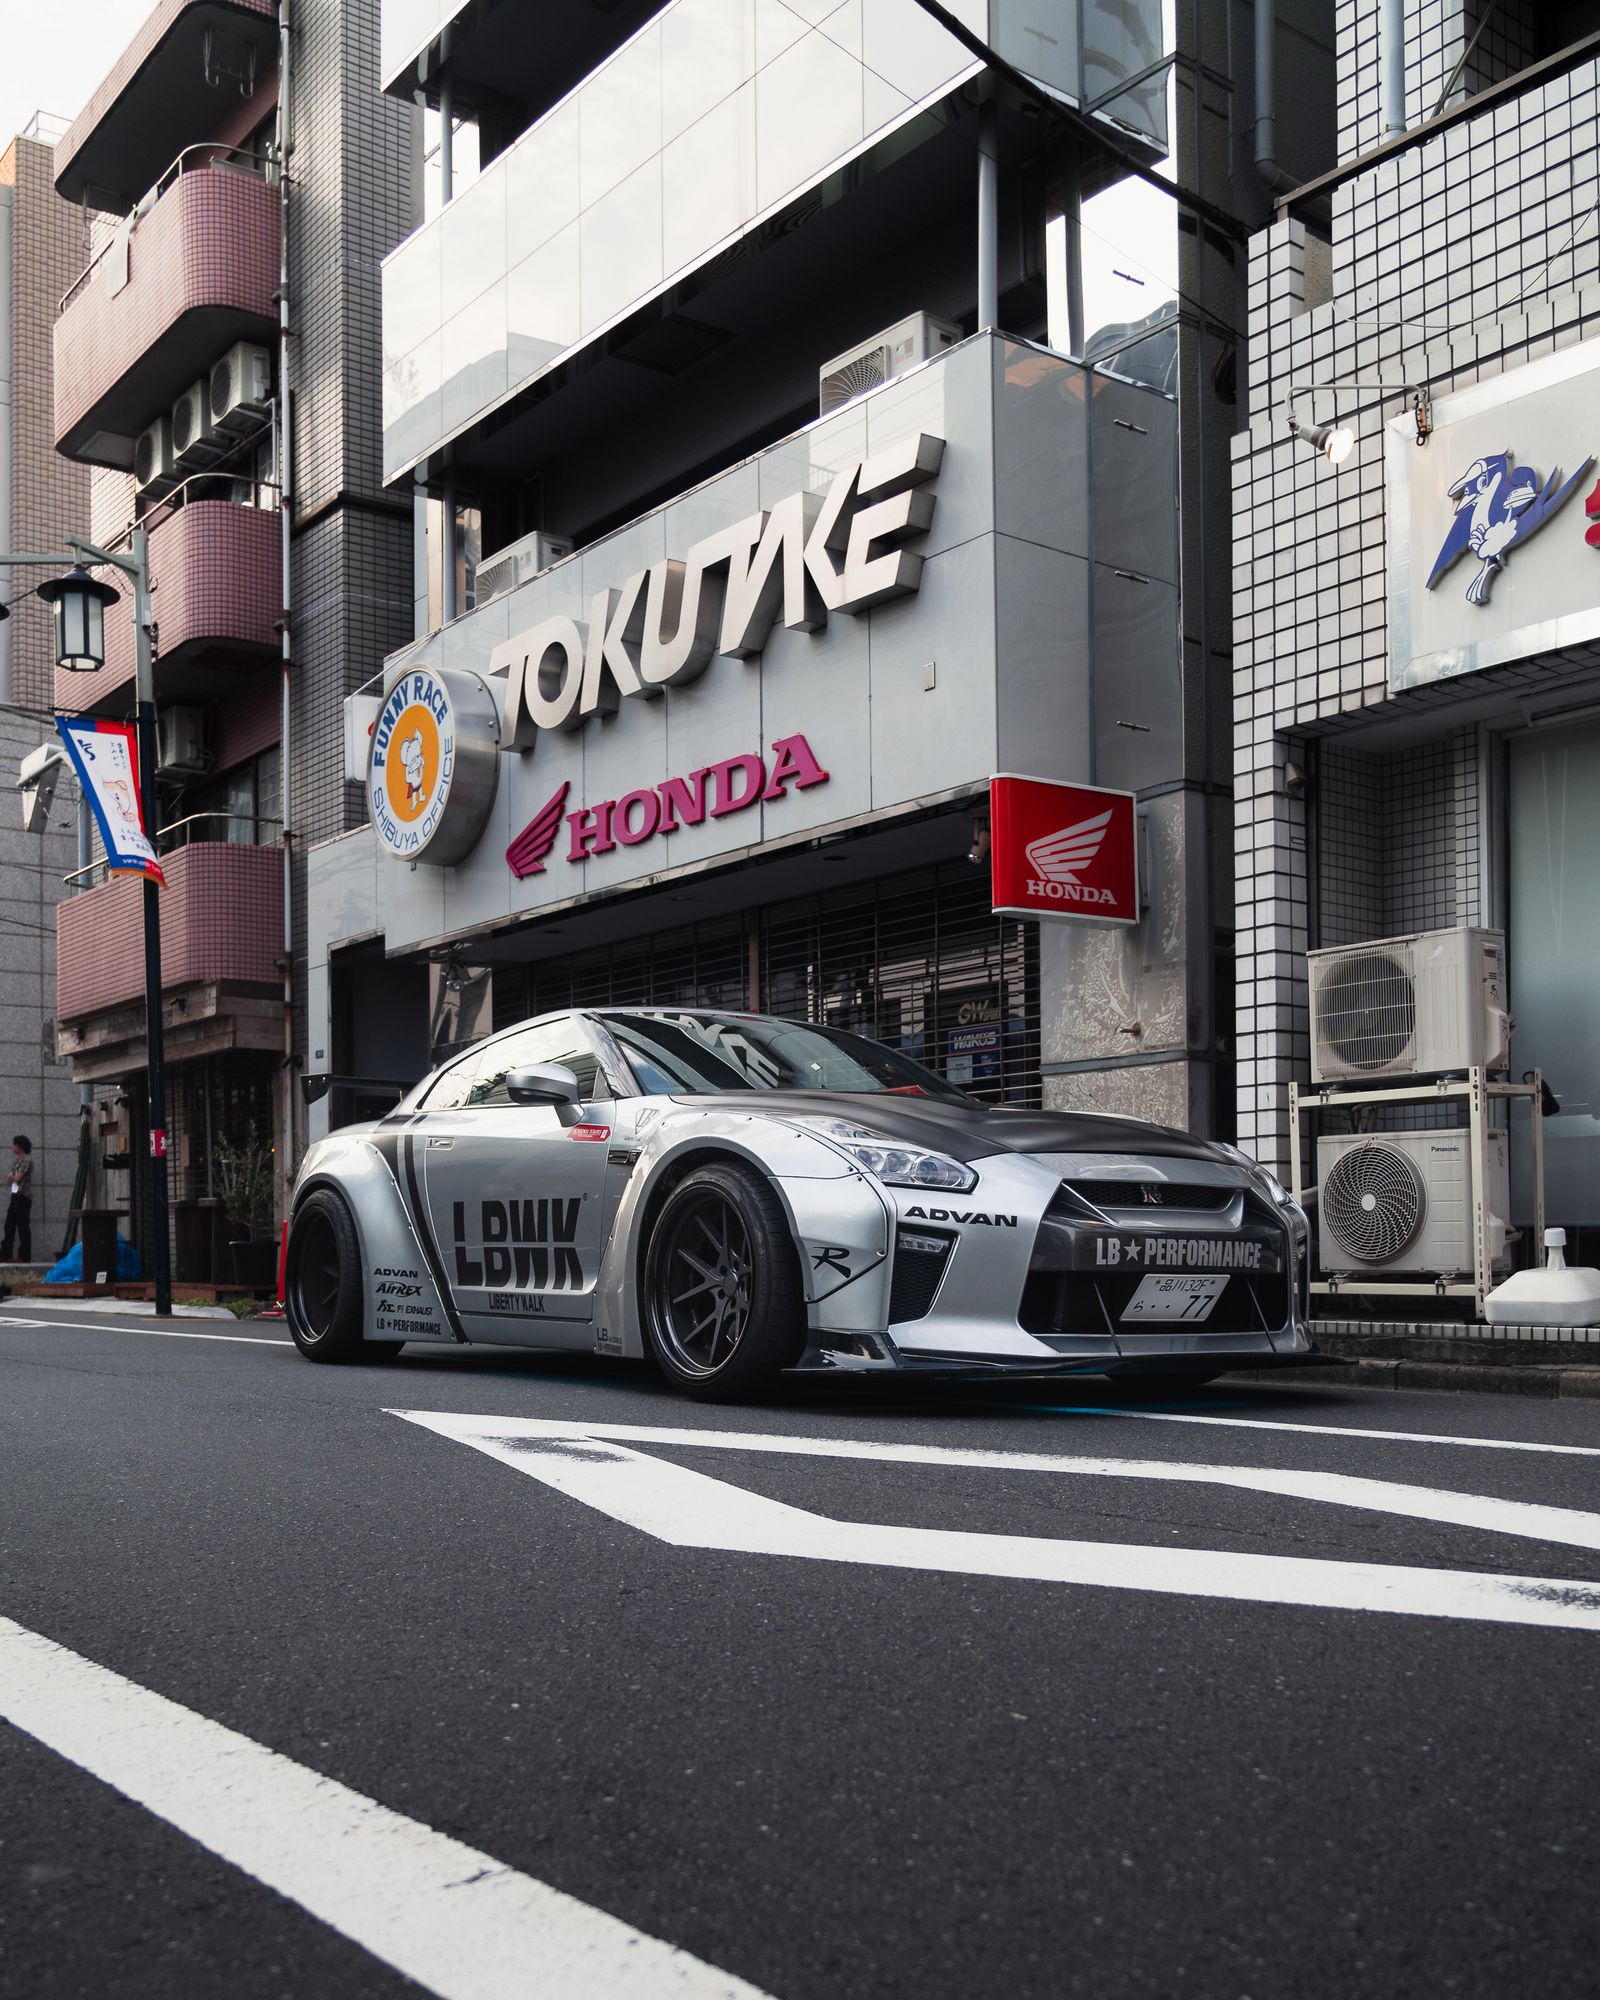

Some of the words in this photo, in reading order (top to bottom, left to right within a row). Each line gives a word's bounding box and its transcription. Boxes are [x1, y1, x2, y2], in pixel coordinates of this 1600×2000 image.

[374, 680, 408, 767] FUNNY
[413, 676, 448, 726] RACE
[374, 786, 419, 850] SHIBUYA
[423, 735, 453, 838] OFFICE
[566, 733, 830, 862] HONDA
[1026, 878, 1118, 906] HONDA
[904, 1205, 1018, 1228] ADVAN
[1096, 1237, 1121, 1267] LB
[1144, 1237, 1261, 1270] PERFORMANCE
[374, 1268, 419, 1278] ADVAN
[405, 1305, 433, 1316] EXHAUST
[376, 1318, 386, 1330] LB
[393, 1319, 441, 1335] PERFORMANCE
